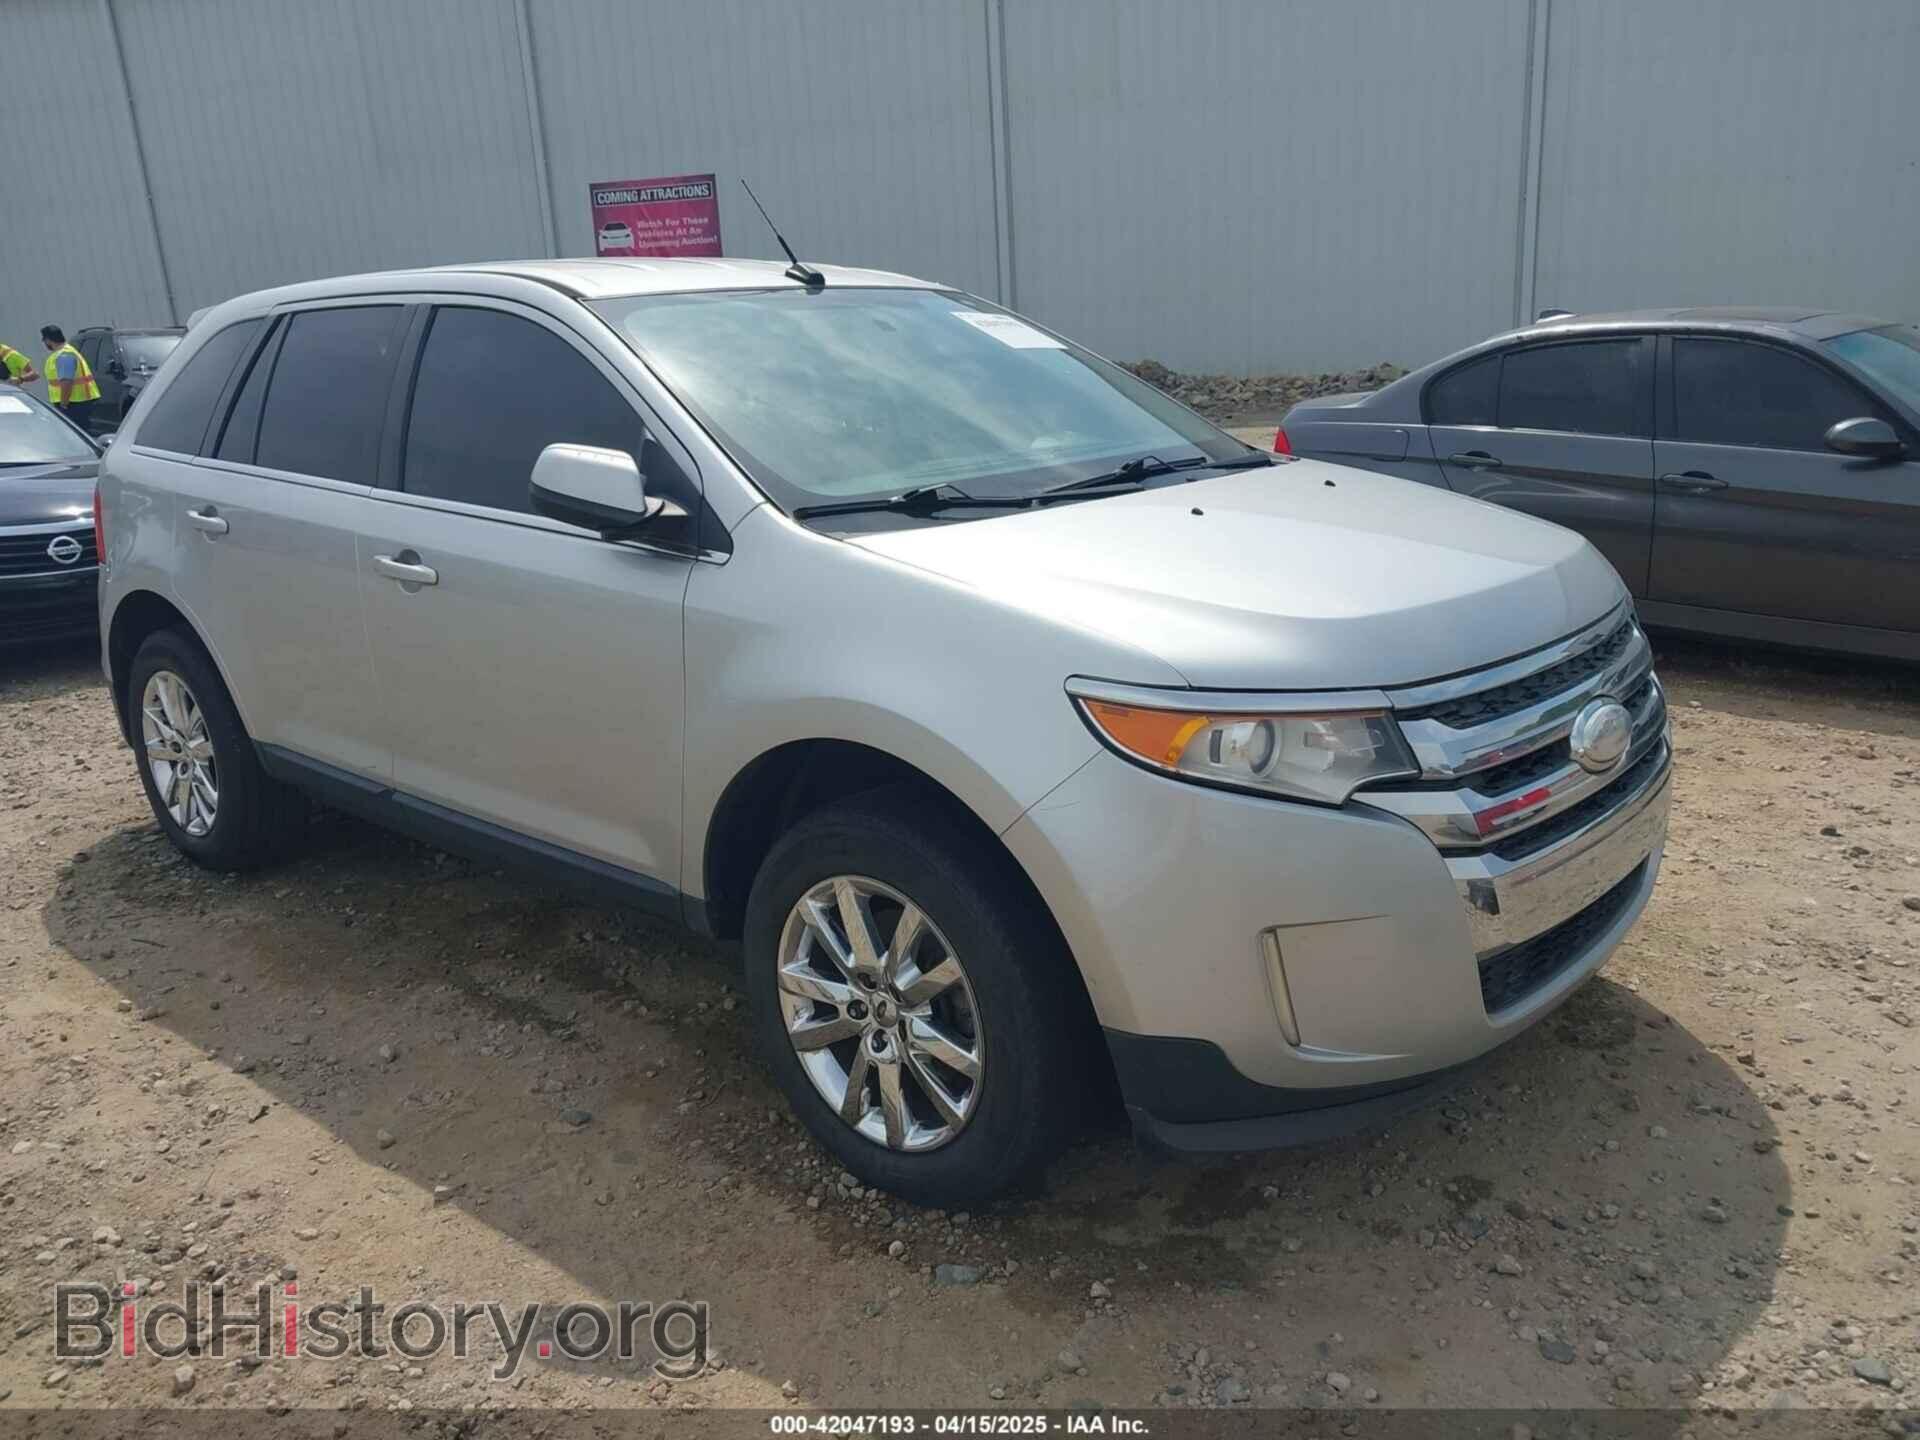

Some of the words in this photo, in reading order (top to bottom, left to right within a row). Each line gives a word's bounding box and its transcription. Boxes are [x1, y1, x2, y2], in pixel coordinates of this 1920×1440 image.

[597, 190, 639, 204] COMING
[640, 185, 709, 201] ATTRACTIONS
[637, 220, 663, 229] Watch
[665, 218, 680, 227] For
[638, 229, 674, 238] Vehicles
[676, 228, 687, 236] At
[638, 239, 680, 249] Upcoming
[681, 235, 718, 246] Auction!
